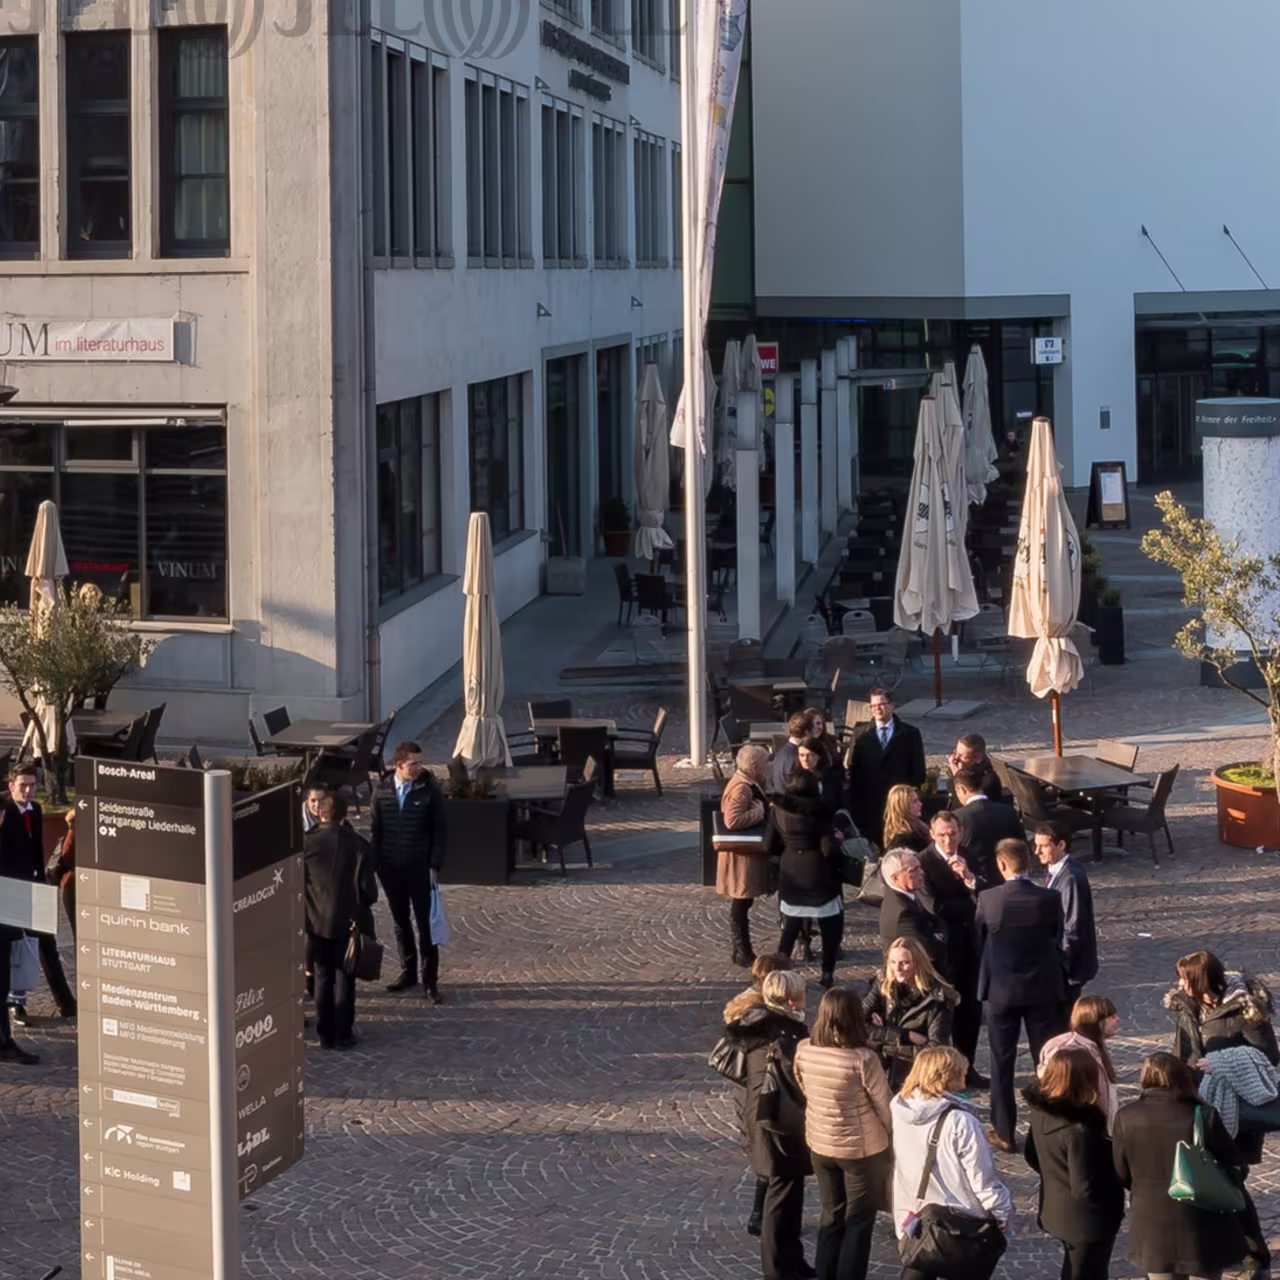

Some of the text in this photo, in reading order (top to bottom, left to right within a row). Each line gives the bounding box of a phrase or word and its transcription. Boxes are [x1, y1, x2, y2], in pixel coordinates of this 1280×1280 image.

[56, 337, 72, 352] im
[76, 336, 165, 352] literaturhaus
[157, 561, 217, 579] VINUM
[98, 765, 156, 781] Bosch-Areal
[98, 801, 155, 818] Seidenstraße
[98, 814, 196, 835] Parkgarage Liederhalle
[100, 913, 190, 936] quirin bank
[101, 958, 152, 973] STUTTGART
[102, 947, 177, 967] LITERATURHAUS
[102, 982, 178, 1004] Medienzentrum
[102, 993, 200, 1021] Baden-Württemberg
[238, 1096, 267, 1119] WELLA
[124, 1170, 160, 1187] Holding
